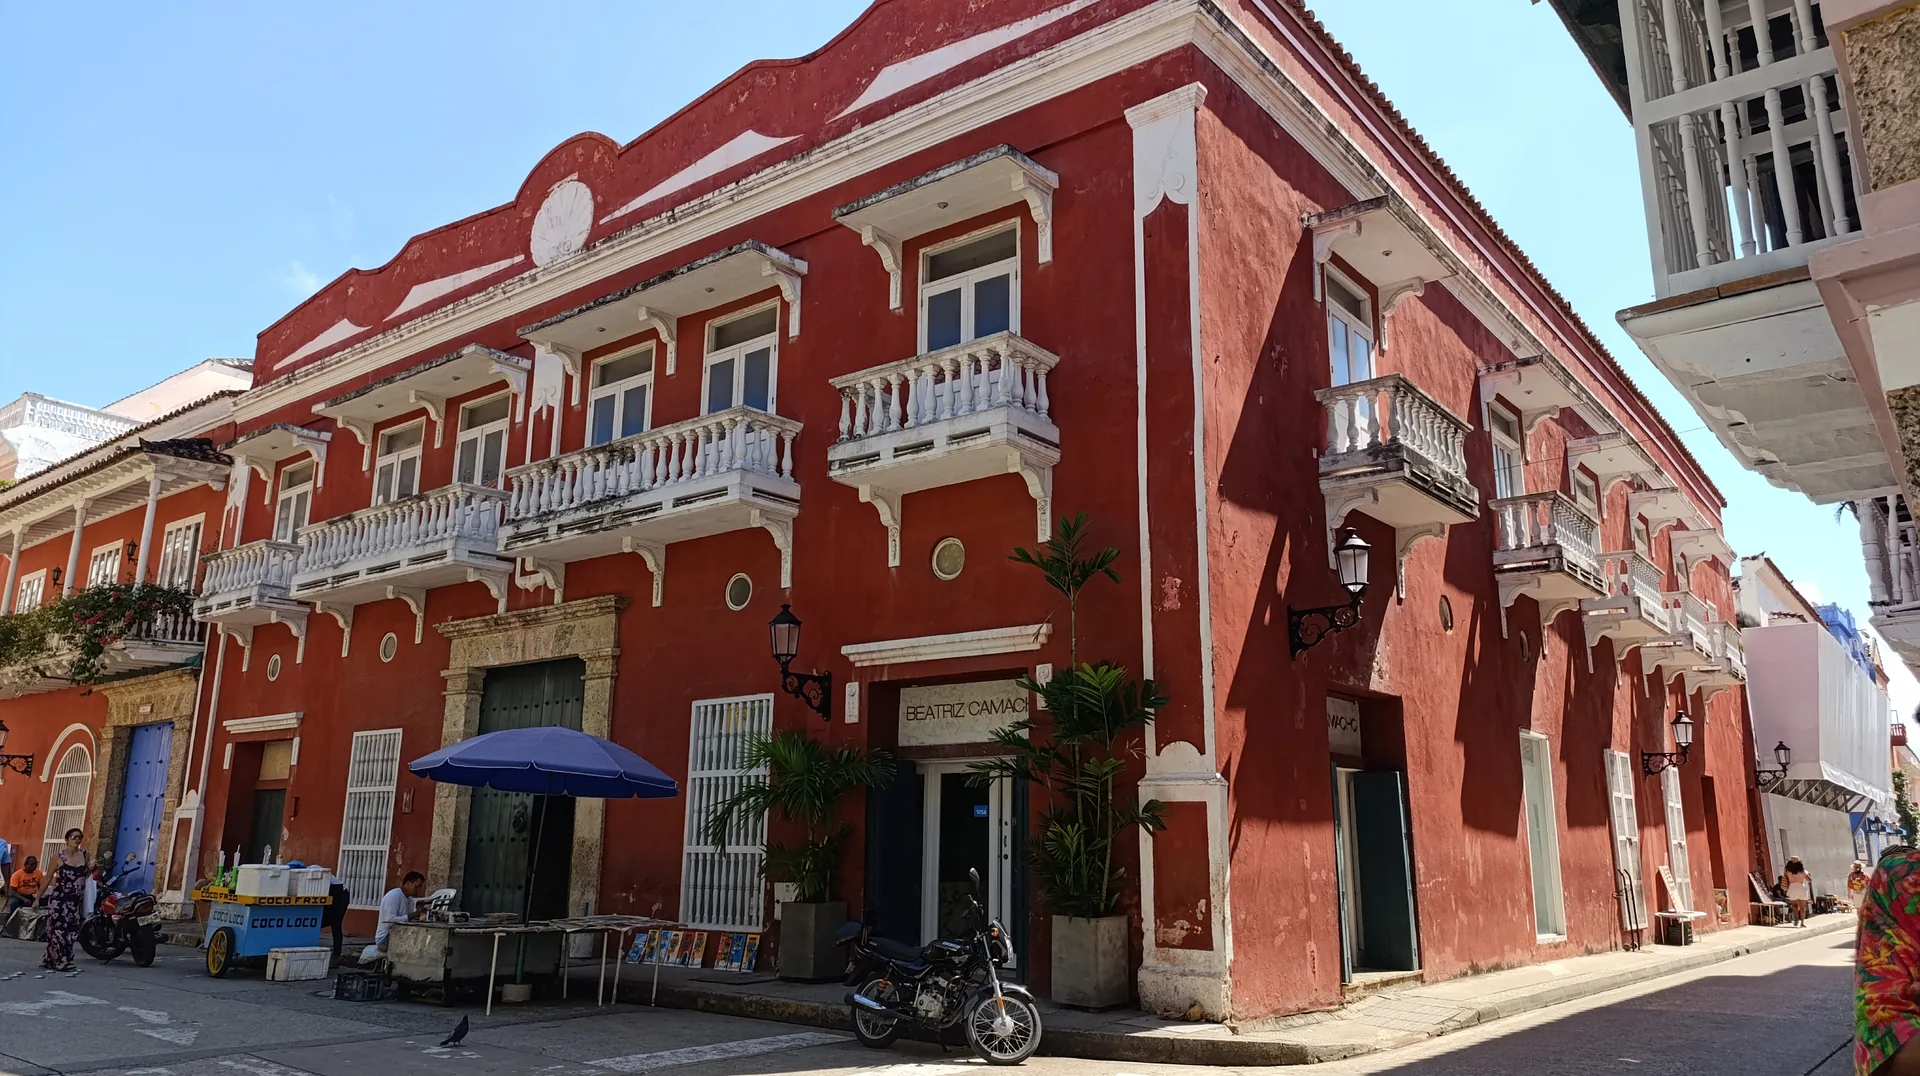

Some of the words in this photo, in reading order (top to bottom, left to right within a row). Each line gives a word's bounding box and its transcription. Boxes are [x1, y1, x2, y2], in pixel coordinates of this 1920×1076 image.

[906, 702, 965, 721] BEATRIZ
[201, 890, 218, 900] COCO
[219, 892, 238, 901] FRIO
[258, 896, 292, 904] COCO
[294, 896, 327, 904] FRIO
[213, 910, 229, 923] COCO
[229, 913, 244, 926] LOCO
[251, 918, 284, 929] COCO
[286, 917, 318, 928] LOCO
